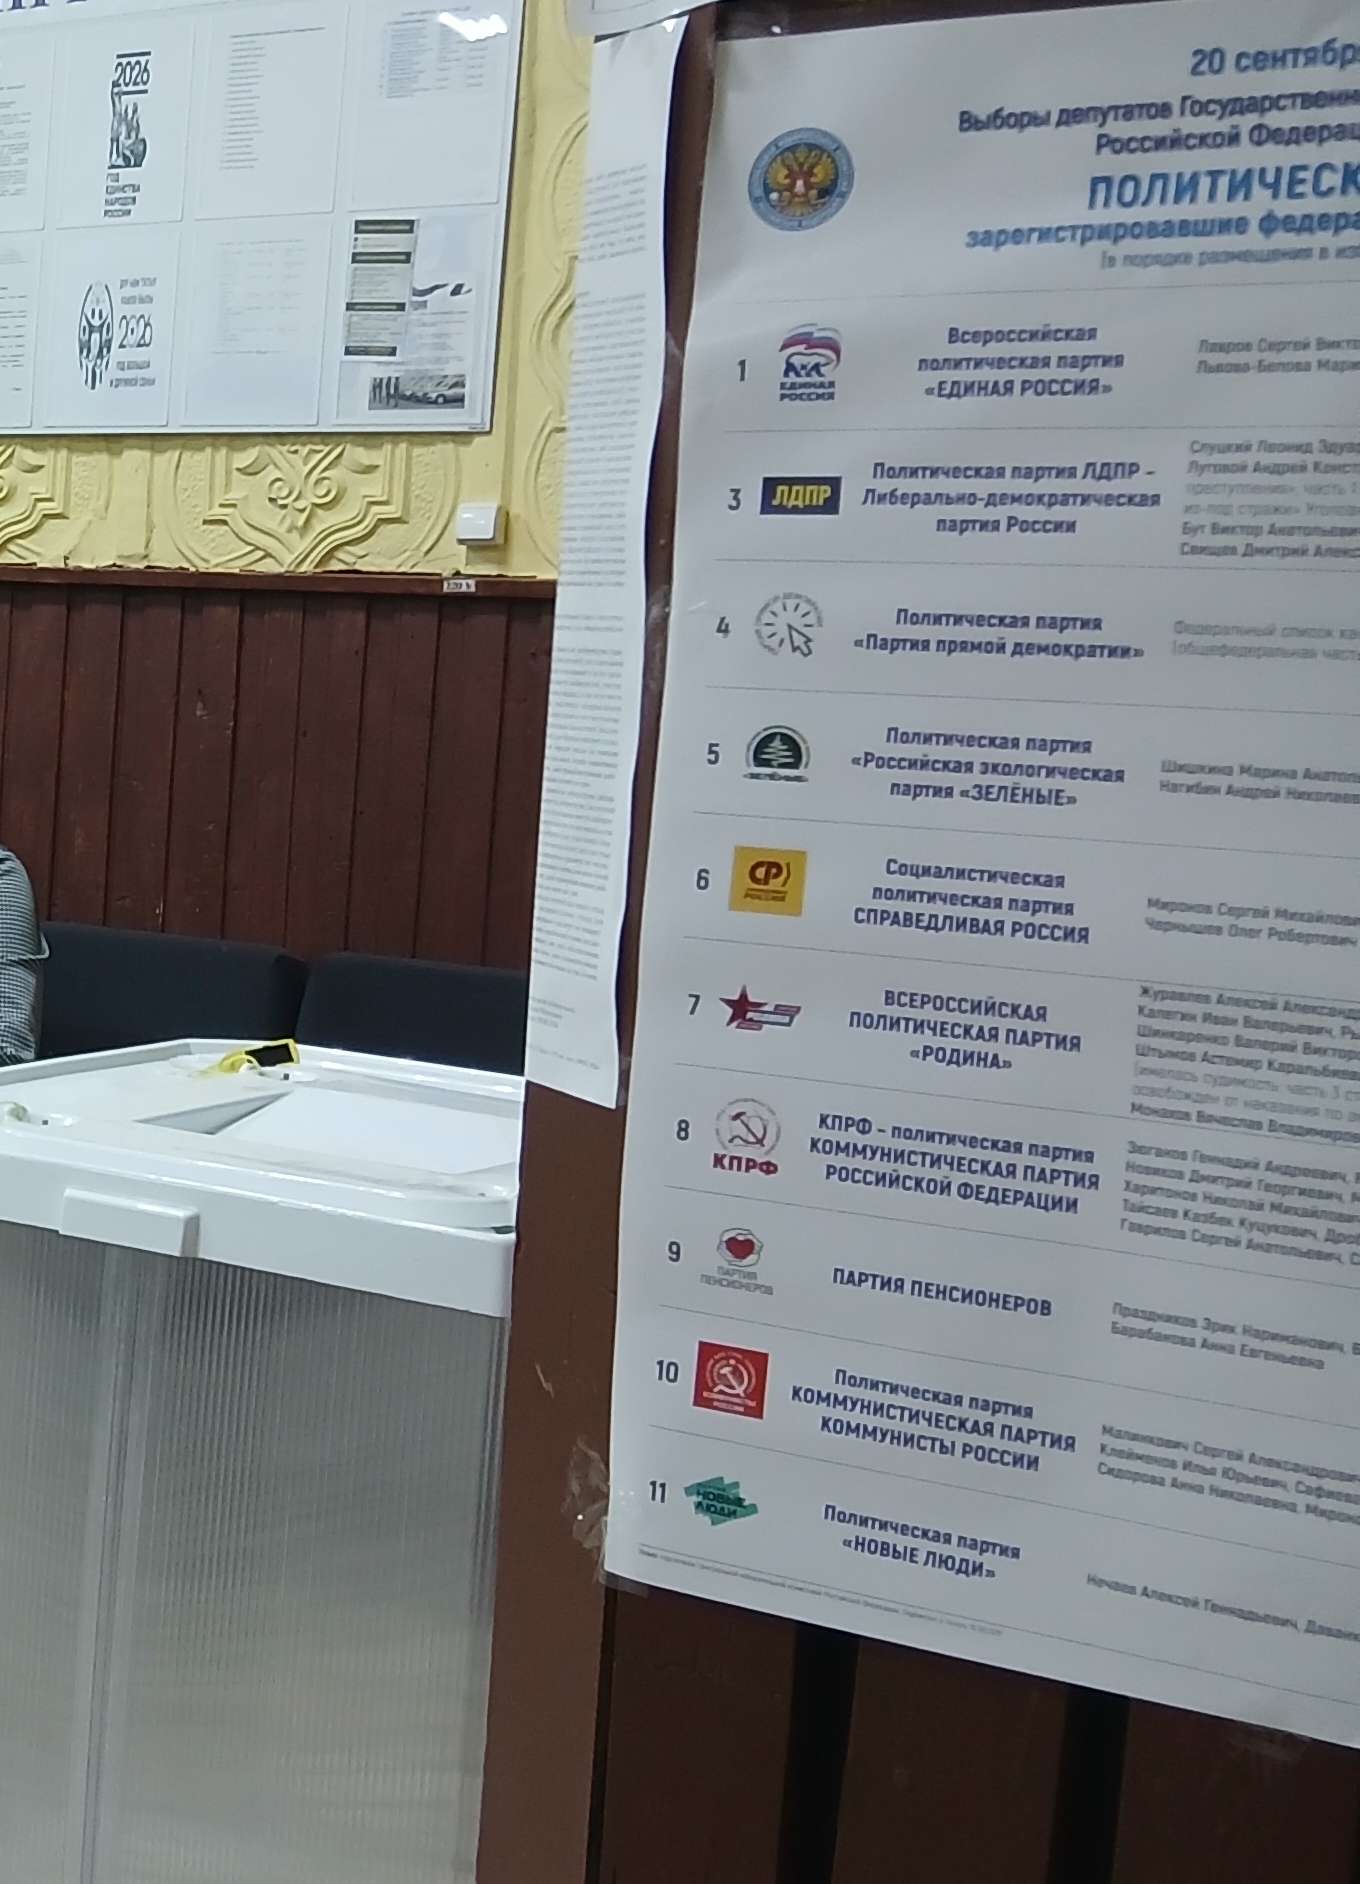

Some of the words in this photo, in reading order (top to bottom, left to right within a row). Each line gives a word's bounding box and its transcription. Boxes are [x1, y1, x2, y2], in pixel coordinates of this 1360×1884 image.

[1191, 47, 1225, 76] 20
[1234, 37, 1360, 75] сентябр
[115, 58, 151, 88] 2026
[958, 107, 1052, 133] Выборы
[1055, 100, 1173, 129] депутатов
[1096, 125, 1240, 155] Российской
[965, 215, 1249, 250] зарегистрировавшие
[118, 313, 153, 349] 2026
[947, 324, 1098, 345] Всероссийская
[737, 358, 748, 382] 1
[917, 354, 1051, 372] политическая
[1056, 352, 1125, 372] партия
[924, 378, 1015, 400] «ЕДИНАЯ
[1020, 378, 1113, 398] РОССИЯ»
[872, 462, 1006, 483] Политическая
[1011, 464, 1078, 484] партия
[1082, 462, 1140, 483] ЛДПР
[727, 488, 741, 512] 3
[772, 485, 832, 507] ЛДПР
[861, 488, 1161, 511] Либерально-демократическая
[935, 516, 1001, 537] партия
[1006, 515, 1077, 535] России
[715, 616, 731, 639] 4
[896, 608, 1030, 631] Политическая
[1035, 614, 1103, 636] партия
[854, 633, 930, 654] «Партия
[936, 636, 1006, 657] прямой
[1011, 641, 1145, 663] демократии»
[706, 743, 720, 765] 5
[886, 727, 1021, 752] Политическая
[1026, 734, 1093, 756] партия
[851, 752, 975, 778] «Российская
[981, 760, 1126, 785] экологическая
[890, 782, 954, 802] партия
[959, 782, 1078, 807] «ЗЕЛЁНЫЕ»
[696, 869, 710, 891] 6
[886, 858, 1066, 889] Социалистическая
[872, 884, 1003, 911] политическая
[1007, 893, 1075, 917] партия
[854, 906, 1005, 937] СПРАВЕДЛИВАЯ
[1010, 920, 1090, 945] РОССИЯ
[687, 994, 701, 1016] 7
[884, 989, 1048, 1022] ВСЕРОССИЙСКАЯ
[848, 1011, 999, 1044] ПОЛИТИЧЕСКАЯ
[1004, 1027, 1081, 1053] ПАРТИЯ
[910, 1045, 1012, 1071] «РОДИНА»
[676, 1118, 690, 1141] 8
[818, 1113, 873, 1136] КПРФ
[890, 1124, 1023, 1155] политическая
[1028, 1139, 1095, 1165] партия
[712, 1152, 779, 1177] КПРФ
[809, 1135, 1017, 1180] КОММУНИСТИЧЕСКАЯ
[1022, 1165, 1100, 1192] ПАРТИЯ
[825, 1163, 953, 1197] РОССИЙСКОЙ
[957, 1181, 1079, 1215] ФЕДЕРАЦИИ
[668, 1242, 681, 1263] 9
[832, 1267, 905, 1295] ПАРТИЯ
[910, 1278, 1052, 1317] ПЕНСИОНЕРОВ
[656, 1360, 679, 1384] 10
[834, 1368, 963, 1409] Политическая
[968, 1392, 1034, 1420] партия
[791, 1385, 995, 1438] КОММУНИСТИЧЕСКАЯ
[999, 1422, 1076, 1453] ПАРТИЯ
[821, 1416, 956, 1457] КОММУНИСТЫ
[961, 1443, 1040, 1472] РОССИИ
[649, 1481, 667, 1503] 11
[824, 1504, 953, 1546] Политическая
[957, 1531, 1021, 1560] партия
[842, 1535, 920, 1565] «НОВЫЕ
[924, 1551, 996, 1579] ЛЮДИ»
